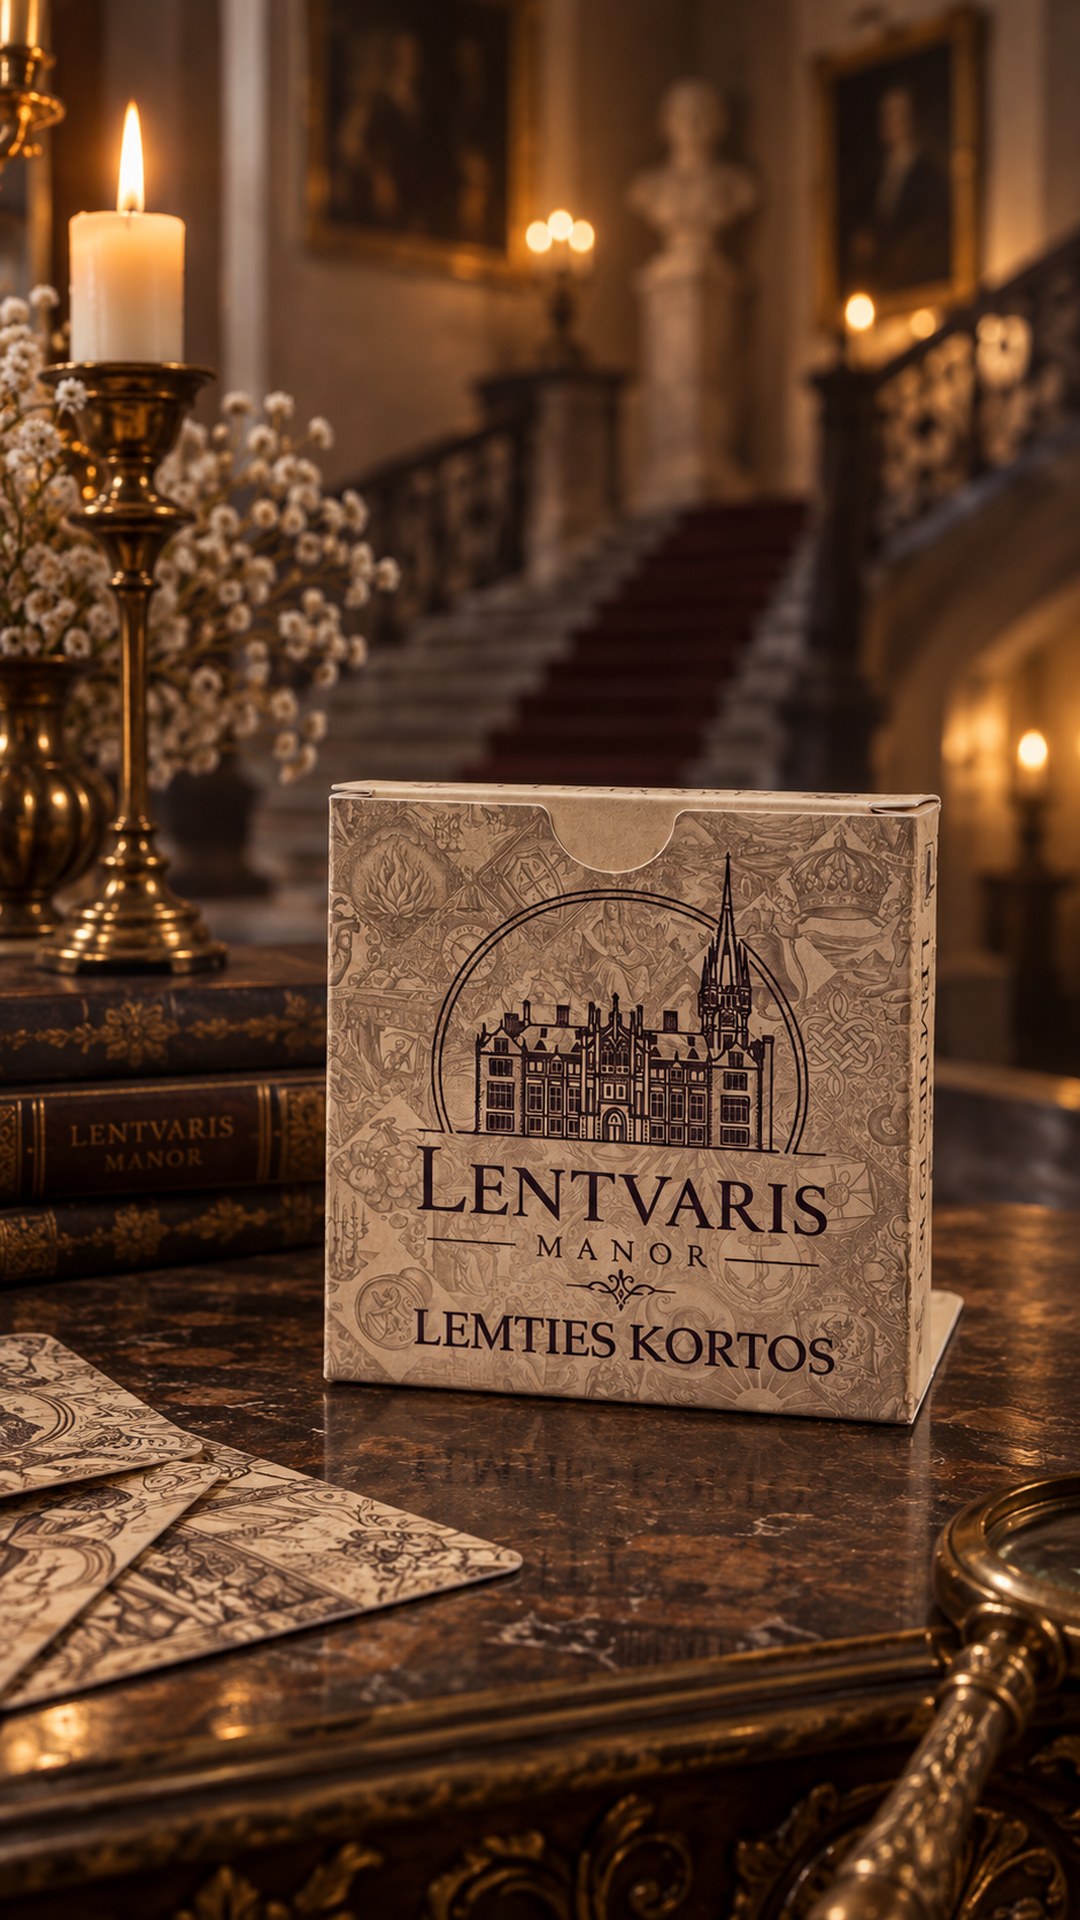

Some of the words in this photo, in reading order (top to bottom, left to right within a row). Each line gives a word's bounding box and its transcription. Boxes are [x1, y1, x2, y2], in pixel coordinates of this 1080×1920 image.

[70, 1115, 235, 1148] LENTVARIS
[104, 1147, 203, 1173] MANOR
[416, 1145, 829, 1237] LENTVARIS
[536, 1234, 709, 1269] MANOR
[413, 1308, 617, 1359] LEMTIES
[630, 1323, 835, 1376] KORTOS
